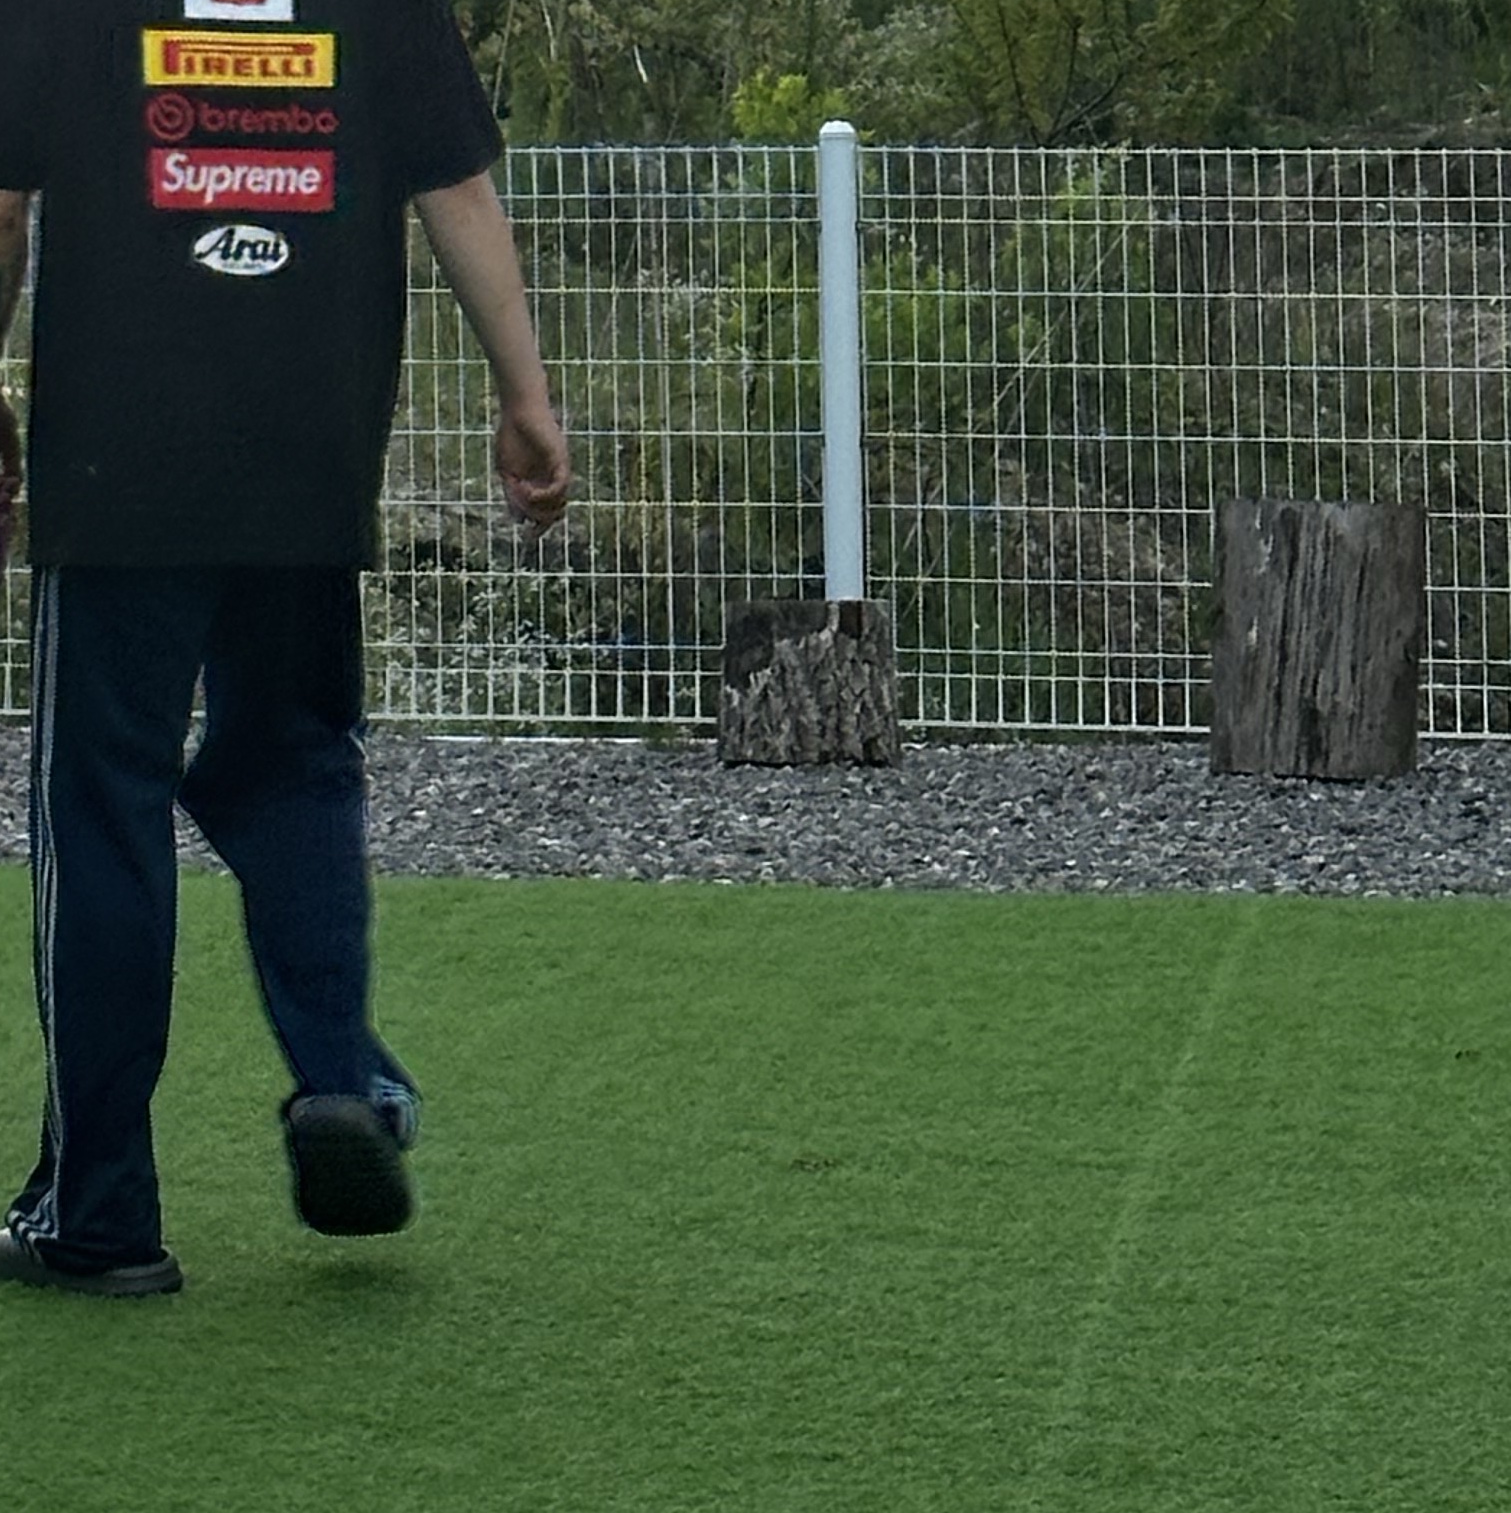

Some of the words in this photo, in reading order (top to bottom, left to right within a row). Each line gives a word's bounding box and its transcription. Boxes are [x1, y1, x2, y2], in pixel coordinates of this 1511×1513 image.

[162, 39, 316, 77] PIRELLI
[200, 102, 338, 133] brembo
[162, 152, 321, 203] Supreme
[195, 228, 285, 261] Arai
